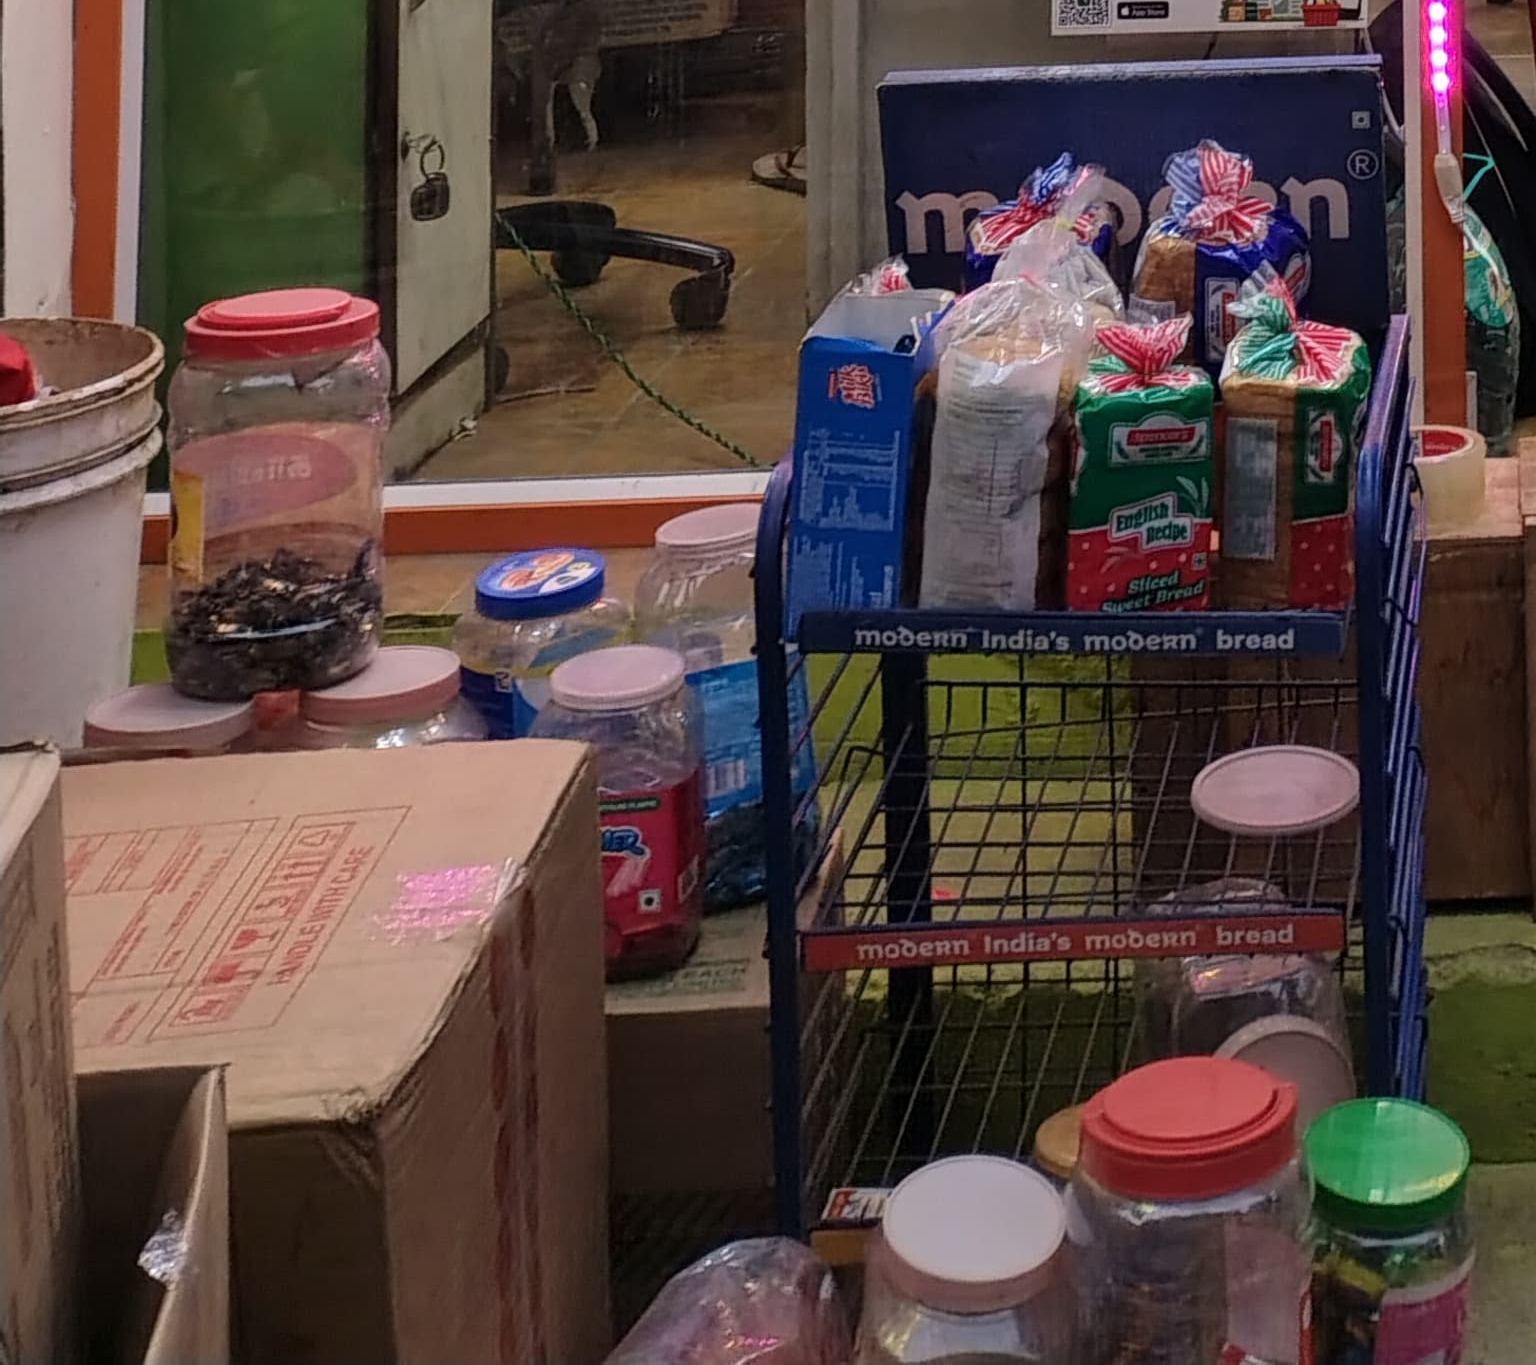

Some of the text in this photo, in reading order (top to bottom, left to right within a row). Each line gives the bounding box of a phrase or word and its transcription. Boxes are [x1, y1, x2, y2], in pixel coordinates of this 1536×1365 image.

[1115, 501, 1170, 532] English
[1146, 523, 1188, 544] Recipe
[1101, 581, 1205, 613] Sweet Bread
[1128, 571, 1180, 595] Sliced
[855, 627, 1295, 652] modern India's modern bread
[266, 846, 375, 986] HANDLE WITH CARE
[857, 922, 1295, 961] modern India's modern bread
